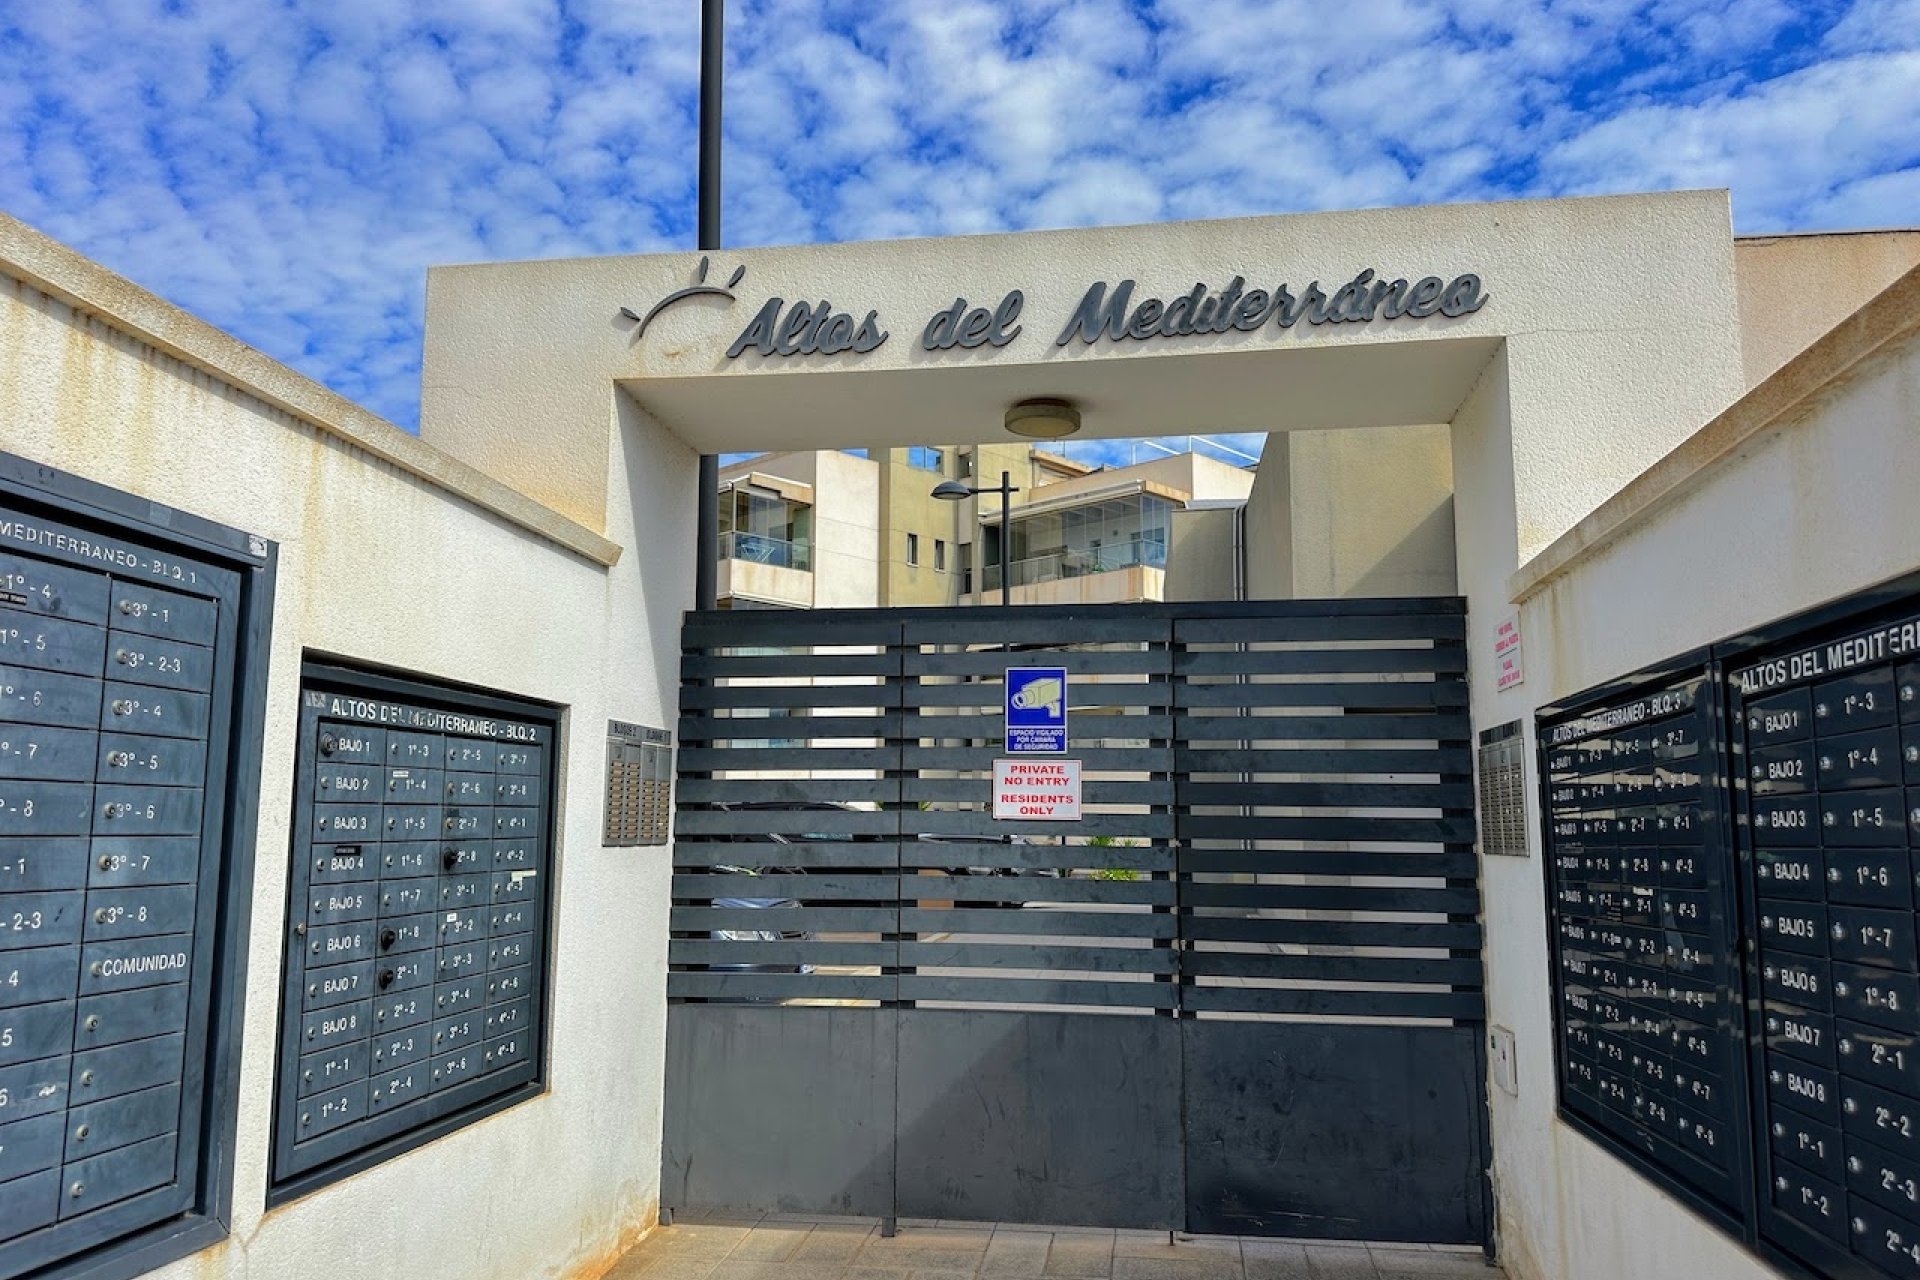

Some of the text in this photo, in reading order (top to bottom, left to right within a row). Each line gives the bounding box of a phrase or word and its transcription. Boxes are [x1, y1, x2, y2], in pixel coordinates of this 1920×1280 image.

[726, 267, 1490, 360] Altos del Mediterráneo
[1741, 622, 1920, 693] ALTOS DEL MEDITER
[332, 699, 376, 719] ALTOS
[1010, 766, 1064, 774] PRIVATE
[1004, 777, 1070, 785] NO ENTRY
[1001, 795, 1073, 803] RESIDENTS
[102, 953, 186, 976] COMUNIDAD
